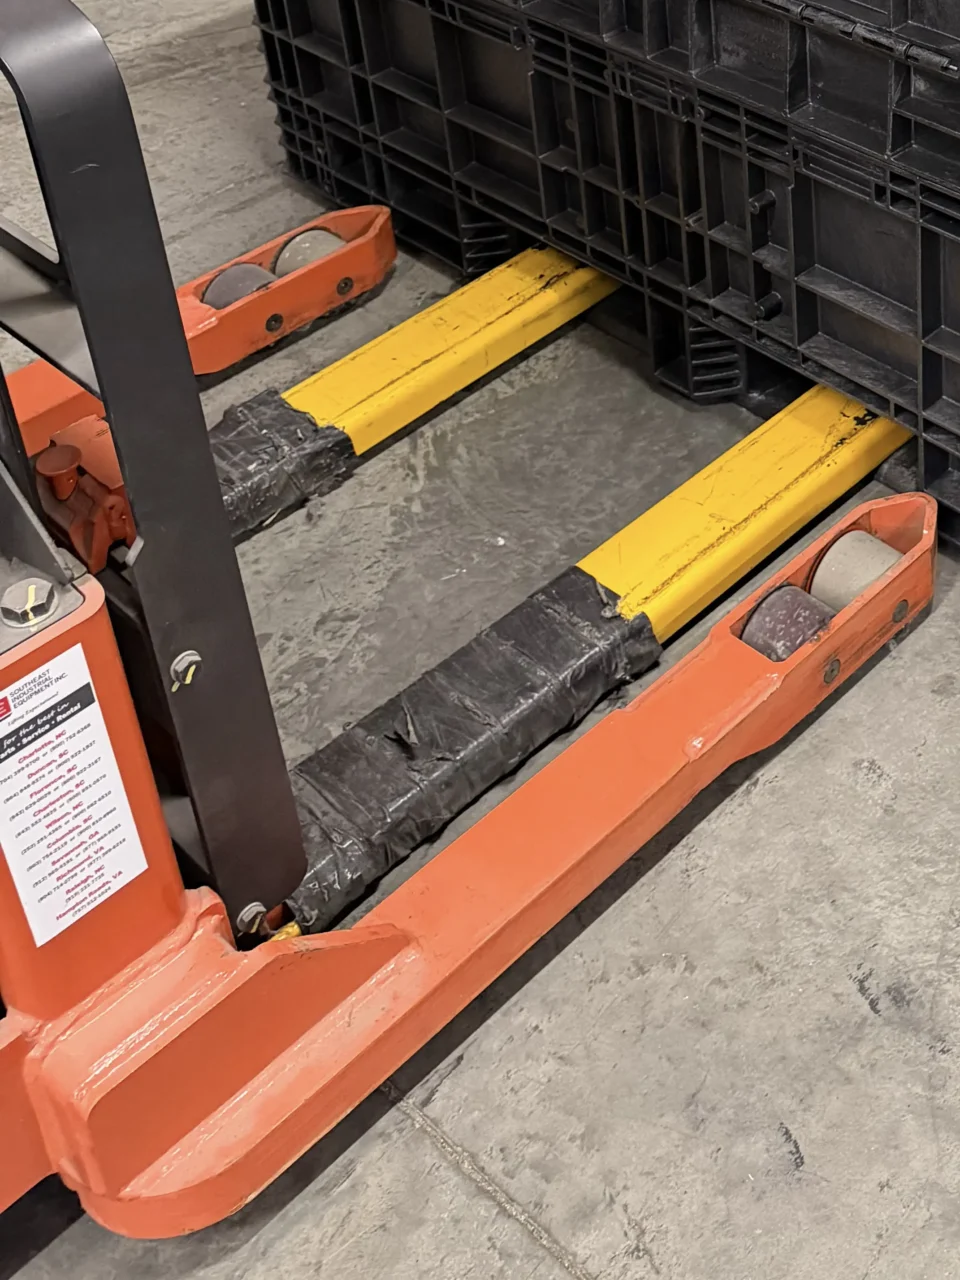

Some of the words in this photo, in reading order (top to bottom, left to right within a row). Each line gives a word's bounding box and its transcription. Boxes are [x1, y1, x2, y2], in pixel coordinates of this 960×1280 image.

[9, 668, 50, 697] SOUTHEAST
[11, 674, 52, 703] INDUSTRIAL
[12, 679, 55, 709] EQUIPMENT
[18, 721, 35, 736] the
[36, 708, 55, 725] best
[56, 700, 69, 712] in
[21, 722, 50, 744] Service
[56, 702, 80, 722] Rental
[17, 737, 54, 764] Charlotte,
[55, 729, 66, 740] NC
[27, 756, 57, 779] Duncan,
[29, 772, 65, 799] Florence,
[32, 786, 74, 818] Charleston,
[72, 800, 83, 811] NC
[46, 822, 81, 849] Columbia,
[51, 838, 87, 867] Savannah,
[55, 853, 92, 882] Richmond,
[93, 844, 104, 855] VA
[65, 872, 93, 896] Raleigh,
[94, 864, 104, 874] NC
[112, 869, 122, 879] VA
